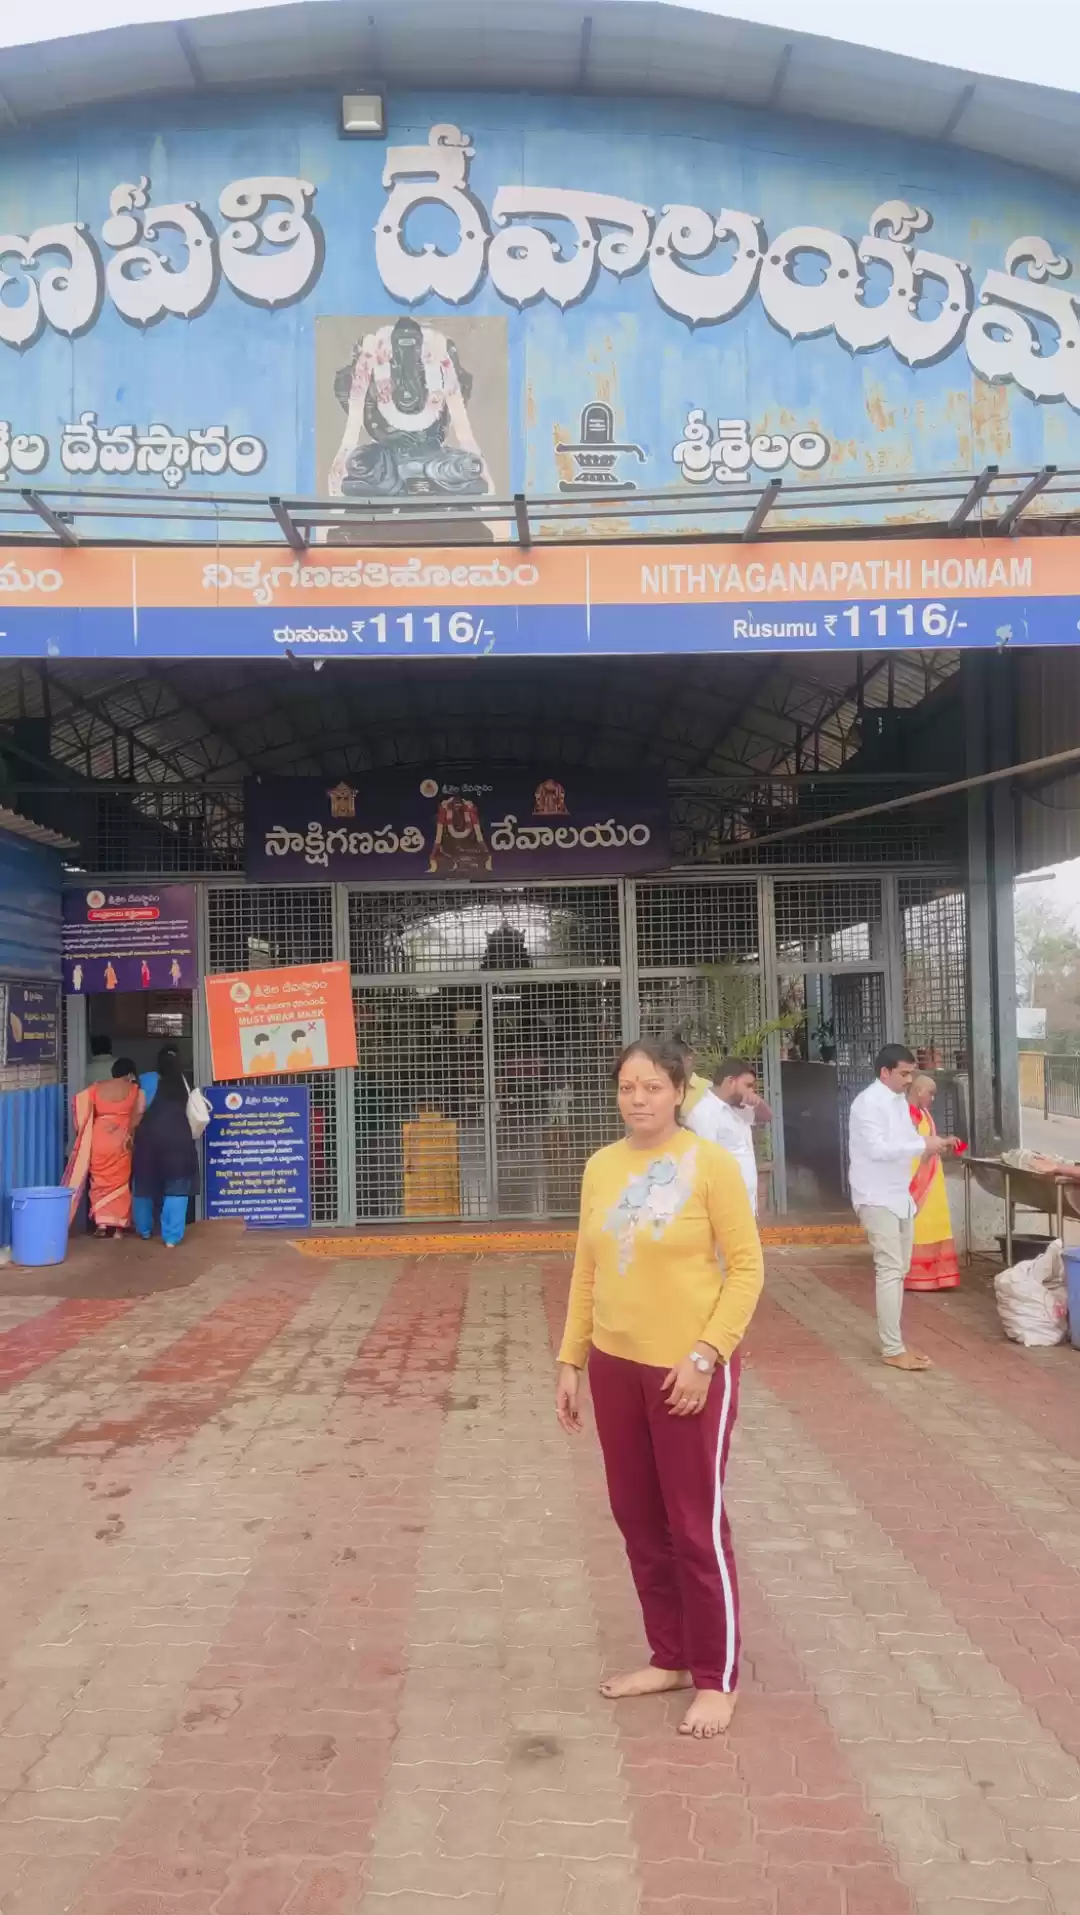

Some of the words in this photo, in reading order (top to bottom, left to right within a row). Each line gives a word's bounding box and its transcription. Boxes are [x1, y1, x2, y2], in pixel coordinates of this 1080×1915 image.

[61, 411, 267, 488] దేవస్థానం
[673, 409, 831, 485] శ్రీశైలం
[641, 559, 912, 594] NITHYAGANAPATHI
[920, 556, 1033, 590] HOMAM
[733, 617, 818, 639] Rusumu
[265, 821, 426, 867] సాక్షిగణపతి
[490, 814, 650, 853] దేవాలయం
[238, 1015, 264, 1025] MUST
[266, 1011, 295, 1022] WEAR
[296, 1008, 325, 1019] MASK
